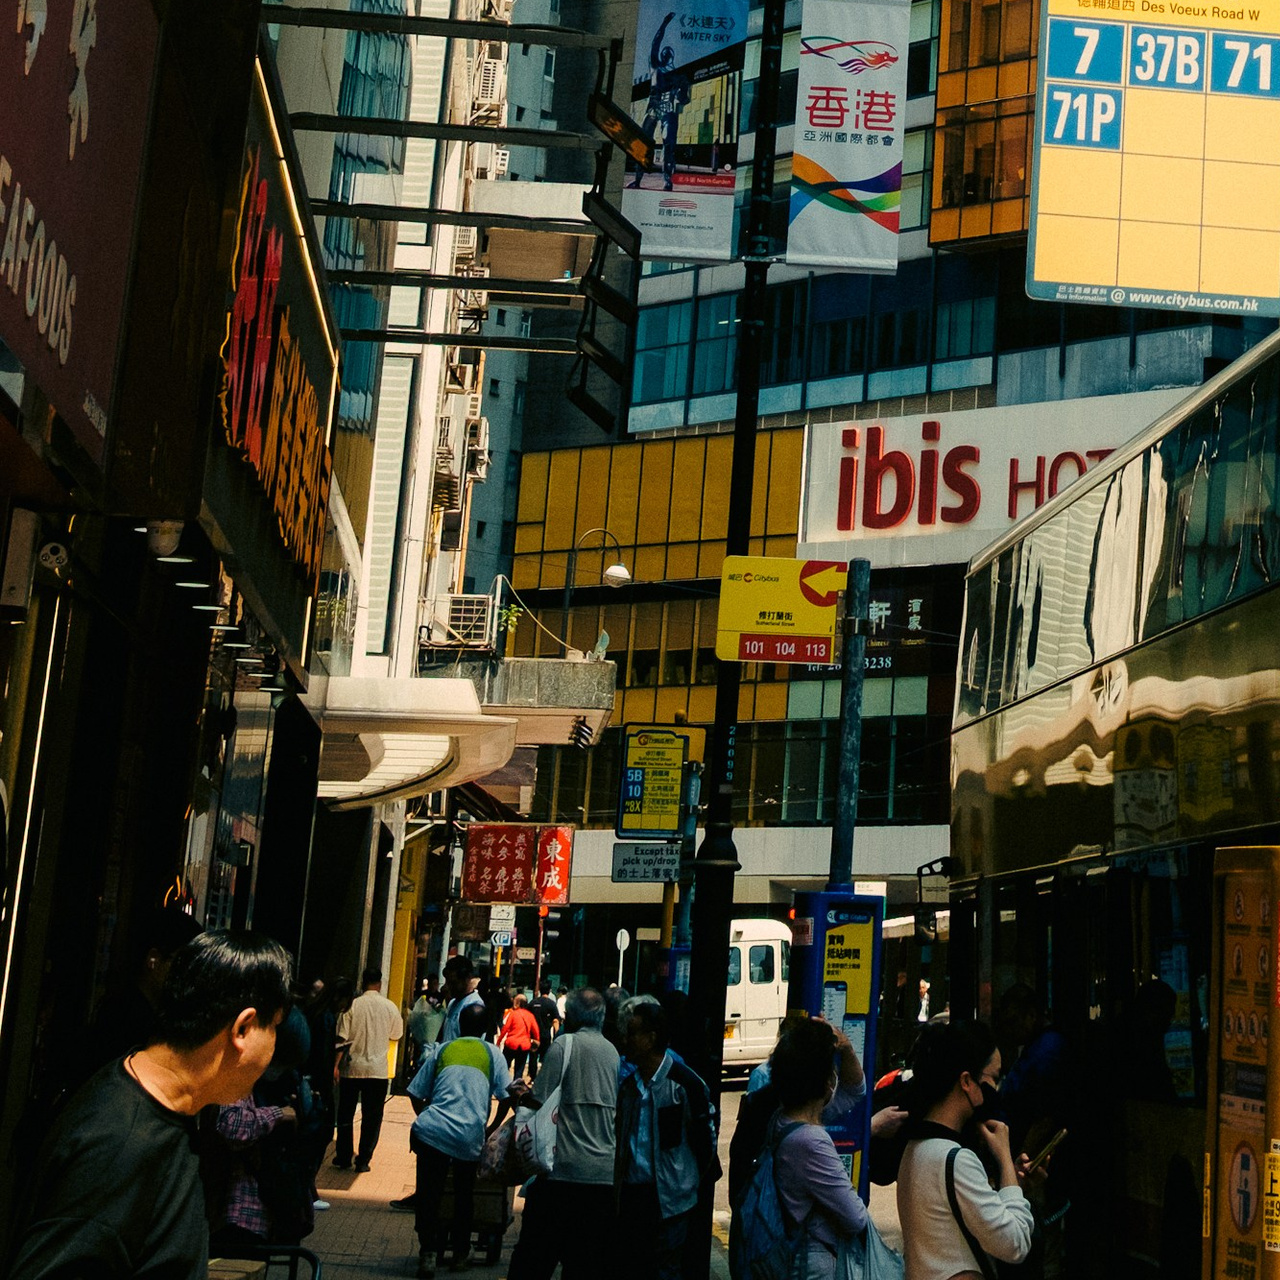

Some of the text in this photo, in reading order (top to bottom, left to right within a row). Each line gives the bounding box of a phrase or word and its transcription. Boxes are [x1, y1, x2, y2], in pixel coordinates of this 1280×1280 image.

[1141, 0, 1166, 14] Des
[1169, 2, 1208, 16] Voeux
[1212, 6, 1245, 20] Road
[1248, 8, 1261, 22] W
[680, 31, 732, 43] WATER SKY
[1073, 28, 1271, 90] 7 37B 71
[805, 86, 897, 131] 香港
[1052, 92, 1116, 142] 71P
[1129, 292, 1259, 312] www.citybus.com.hk
[836, 420, 1118, 532] ibis HO
[744, 640, 826, 657] 101 104 113
[627, 769, 643, 782] 5B
[628, 785, 641, 798] 10
[634, 845, 681, 857] Except tax
[541, 838, 565, 890] 東成
[622, 856, 677, 868] pick up/drop
